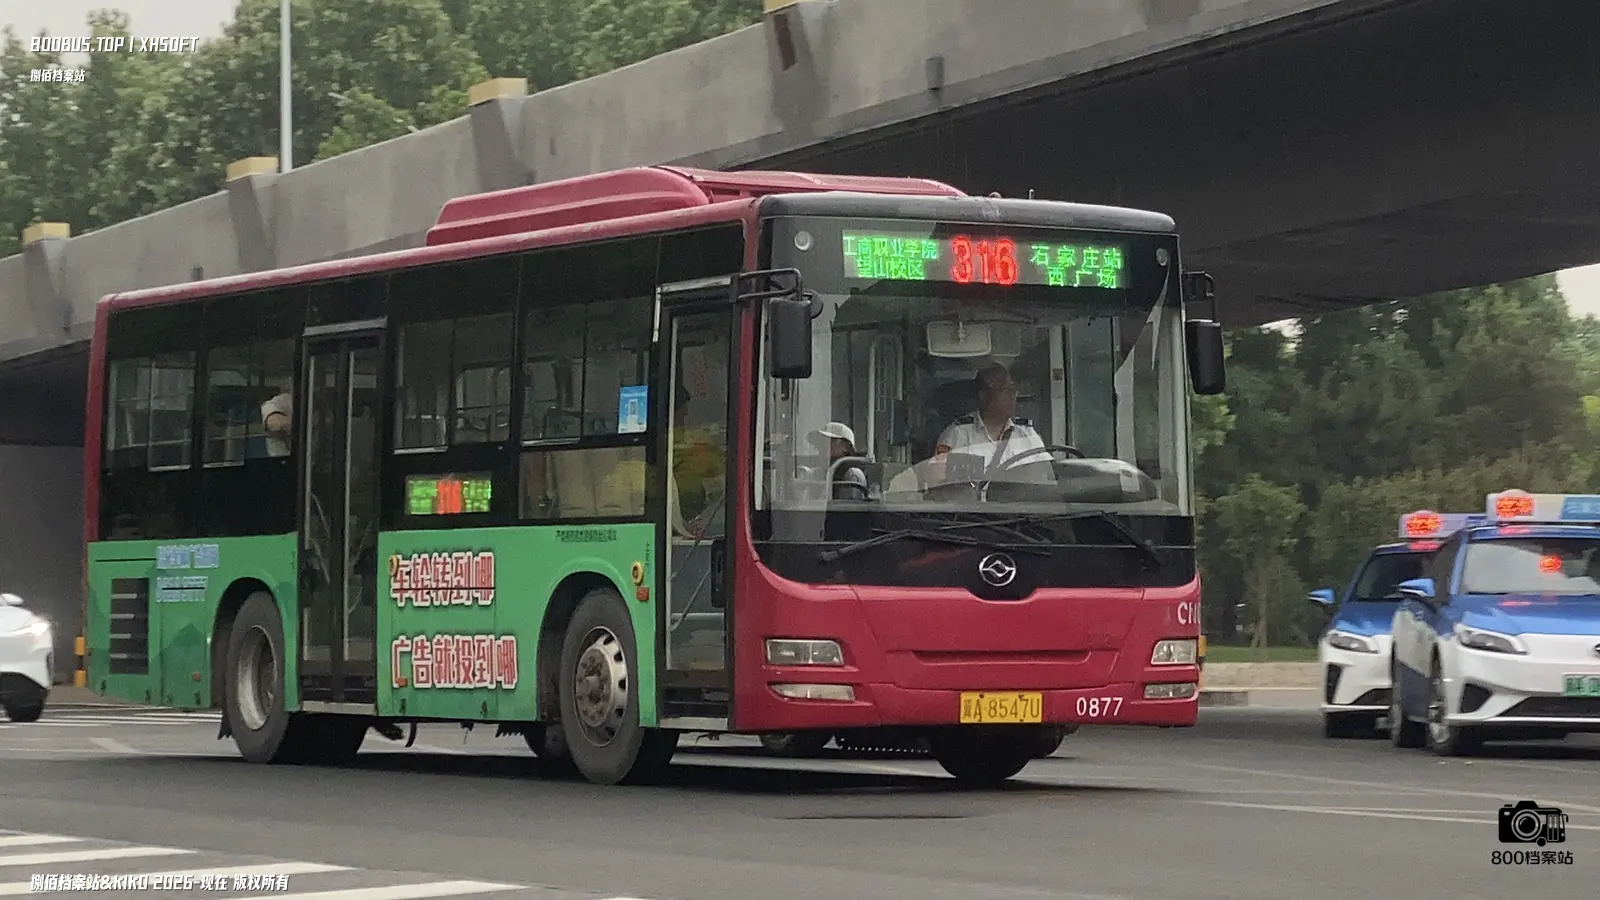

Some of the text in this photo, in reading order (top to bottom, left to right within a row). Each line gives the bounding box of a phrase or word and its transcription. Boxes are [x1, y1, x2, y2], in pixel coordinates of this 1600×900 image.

[842, 235, 939, 260] 工商职业学院
[952, 235, 1017, 285] 316
[1030, 244, 1122, 270] 石家庄站
[856, 257, 925, 280] 望山校区
[1049, 265, 1117, 289] 西广场
[391, 552, 495, 606] 车轮转到哪
[392, 635, 517, 689] 广告就投到哪
[1076, 696, 1123, 718] 0877
